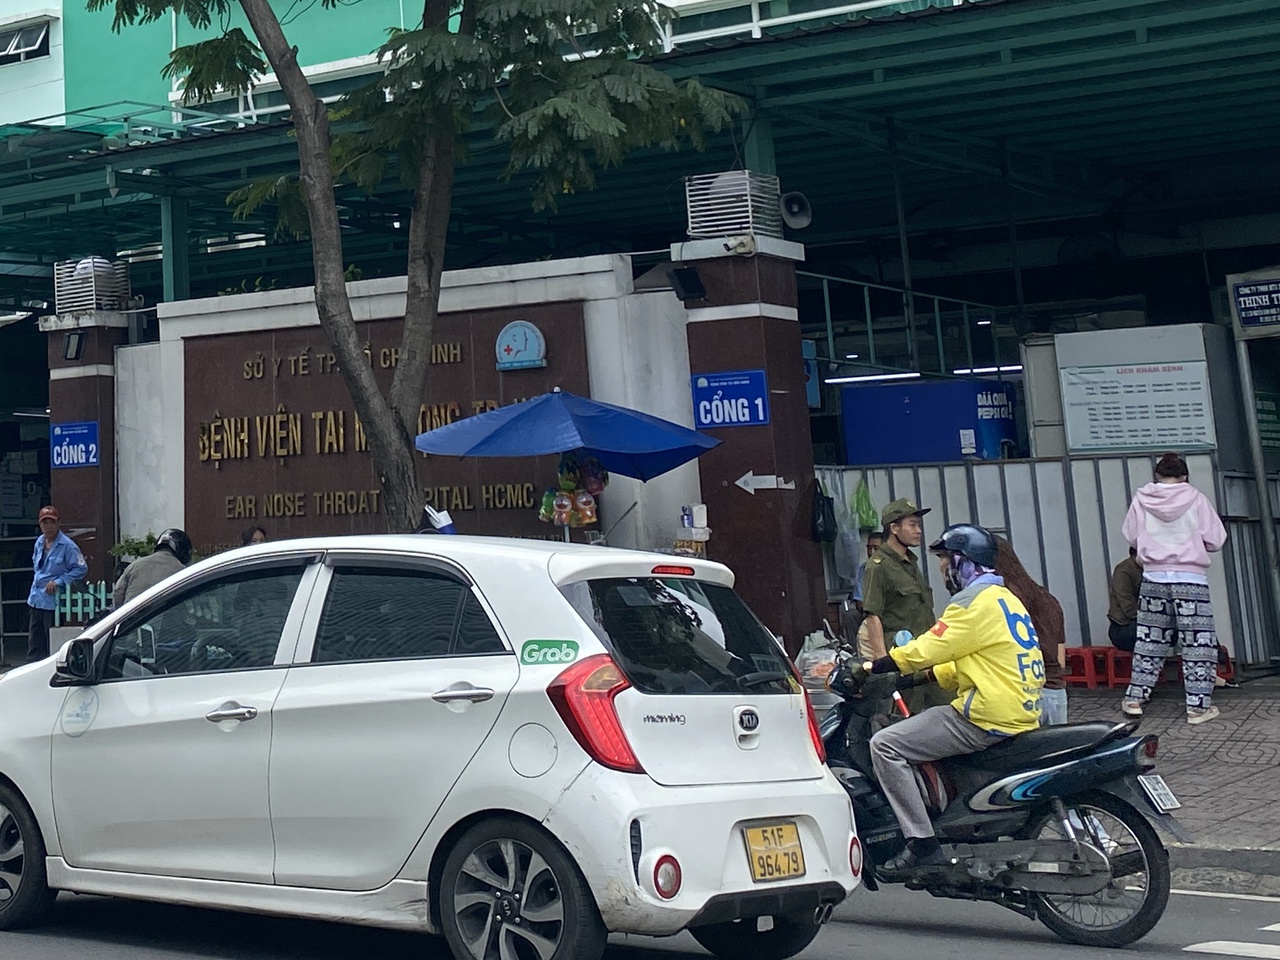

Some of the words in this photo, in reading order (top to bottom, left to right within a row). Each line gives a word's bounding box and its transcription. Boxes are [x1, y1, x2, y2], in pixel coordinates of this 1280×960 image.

[243, 351, 265, 380] SỞ
[271, 356, 283, 378] Y
[288, 346, 312, 376] TẾ
[316, 352, 340, 374] TP.
[380, 347, 403, 369] CH
[431, 343, 462, 365] INH
[699, 390, 750, 424] CỔNG
[754, 397, 764, 421] 1
[53, 437, 86, 465] CỔNG
[88, 443, 97, 463] 2
[199, 409, 250, 471] BỆNH
[255, 403, 303, 467] VIỆN
[311, 410, 345, 455] TAI
[225, 496, 256, 520] EAR
[263, 492, 305, 518] NOSE
[312, 489, 381, 516] THROAT
[481, 482, 535, 509] HCMC
[523, 642, 577, 664] Grab
[741, 714, 759, 728] KIA
[761, 827, 784, 848] 51F
[757, 851, 800, 878] 964.79
